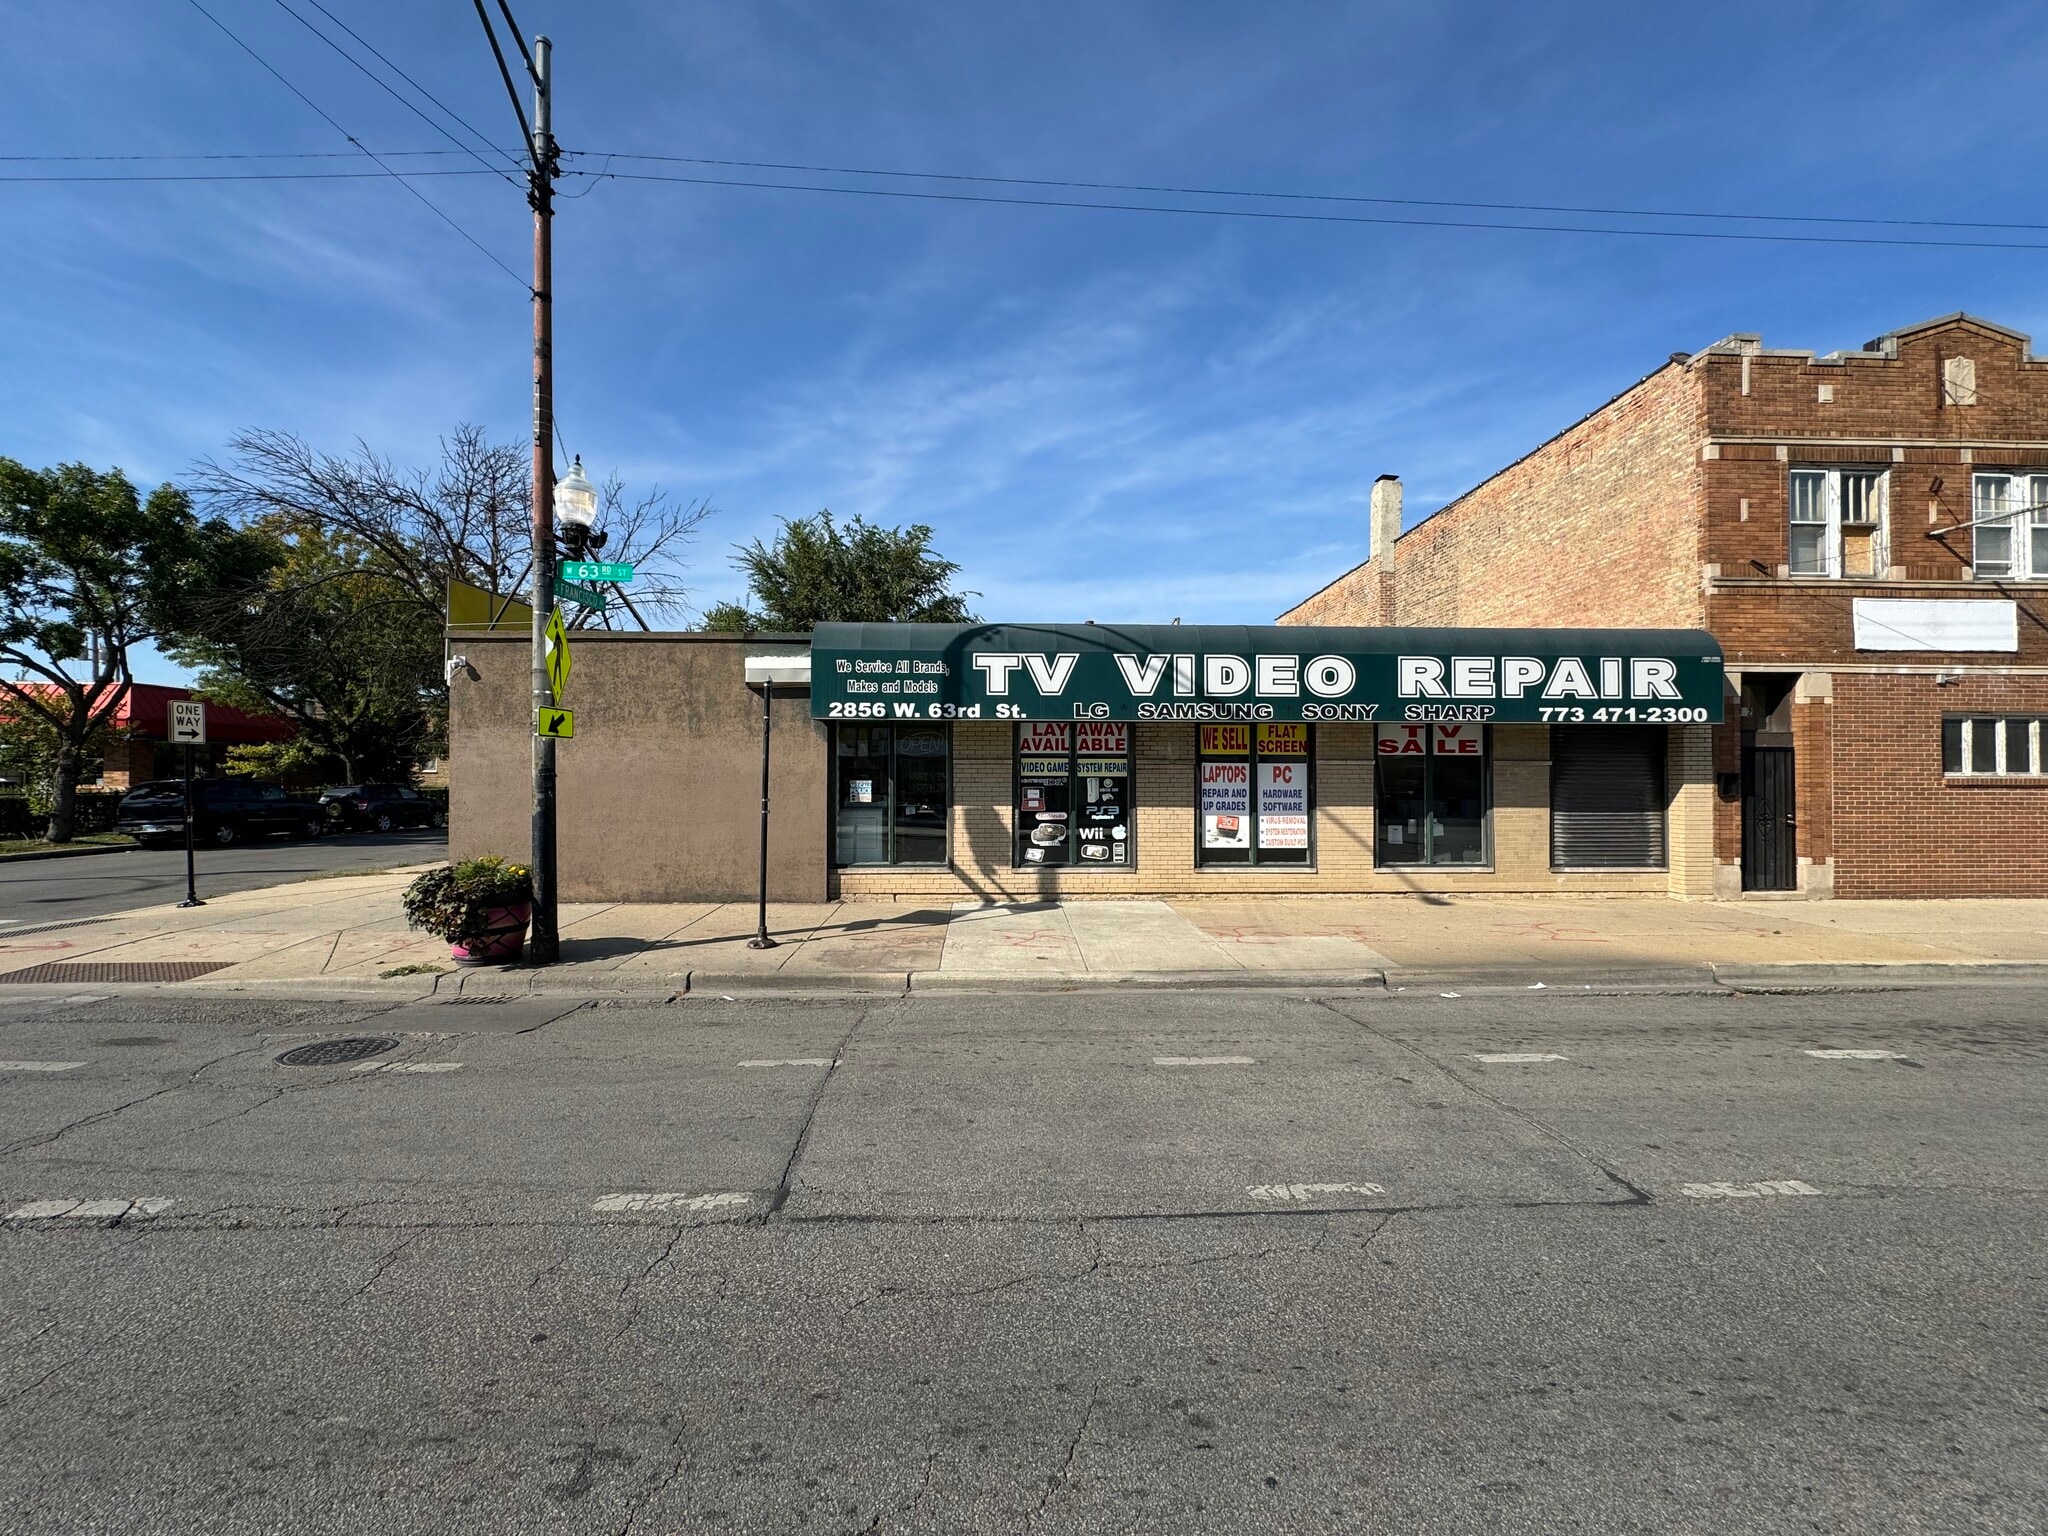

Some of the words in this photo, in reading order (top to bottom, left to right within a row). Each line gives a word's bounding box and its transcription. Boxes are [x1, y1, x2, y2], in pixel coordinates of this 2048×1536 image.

[566, 566, 573, 574] W
[618, 568, 627, 577] ST
[560, 583, 598, 607] FRANCISCO
[836, 660, 852, 673] We
[855, 660, 893, 673] Service
[895, 660, 910, 673] All
[913, 660, 950, 676] Brands,
[973, 653, 1080, 696] TV
[1113, 653, 1356, 698] VIDEO
[1397, 655, 1683, 699] REPAIR
[847, 680, 879, 693] Makes
[882, 680, 900, 693] and
[904, 680, 938, 693] Models
[176, 704, 200, 716] ONE
[829, 702, 886, 718] 2856
[893, 702, 921, 718] W.
[928, 702, 981, 718] 63rd
[995, 703, 1027, 718] St.
[1074, 702, 1110, 719] LG
[1138, 702, 1274, 720] SAMSUNG
[1302, 703, 1379, 720] SONY
[1404, 704, 1496, 721] SHARP
[1538, 707, 1585, 722] 773
[1592, 707, 1708, 722] 471-2300
[176, 715, 201, 727] WAY
[1032, 723, 1069, 736] LAY
[1077, 723, 1125, 737] AWAY
[1268, 725, 1298, 738] FLAT
[900, 735, 943, 752] OPEN
[1202, 727, 1218, 750] WE
[1222, 727, 1248, 750] SELL
[1258, 740, 1308, 753] SCREEN
[1021, 762, 1045, 773] VIDEO
[1047, 762, 1069, 773] GAME
[1077, 762, 1103, 773] SYSTEM
[1105, 762, 1127, 773] REPAIR
[1202, 765, 1247, 783] LAPTOPS
[1272, 765, 1292, 784] PC
[1202, 788, 1229, 798] REPAIR
[1231, 788, 1247, 798] AND
[1262, 789, 1303, 799] HARDWARE
[1086, 805, 1120, 815] PS3
[1203, 801, 1214, 811] UP
[1216, 801, 1246, 811] GRADES
[1262, 802, 1303, 812] SOFTWARE
[1265, 816, 1281, 825] VIRUS
[1282, 816, 1306, 825] REMOVAL
[1079, 827, 1104, 840] Wii
[1265, 827, 1280, 836] SYSTEM
[1281, 827, 1306, 836] RESTORATION
[1265, 838, 1283, 846] CUSTOM
[1284, 838, 1296, 846] BUILT
